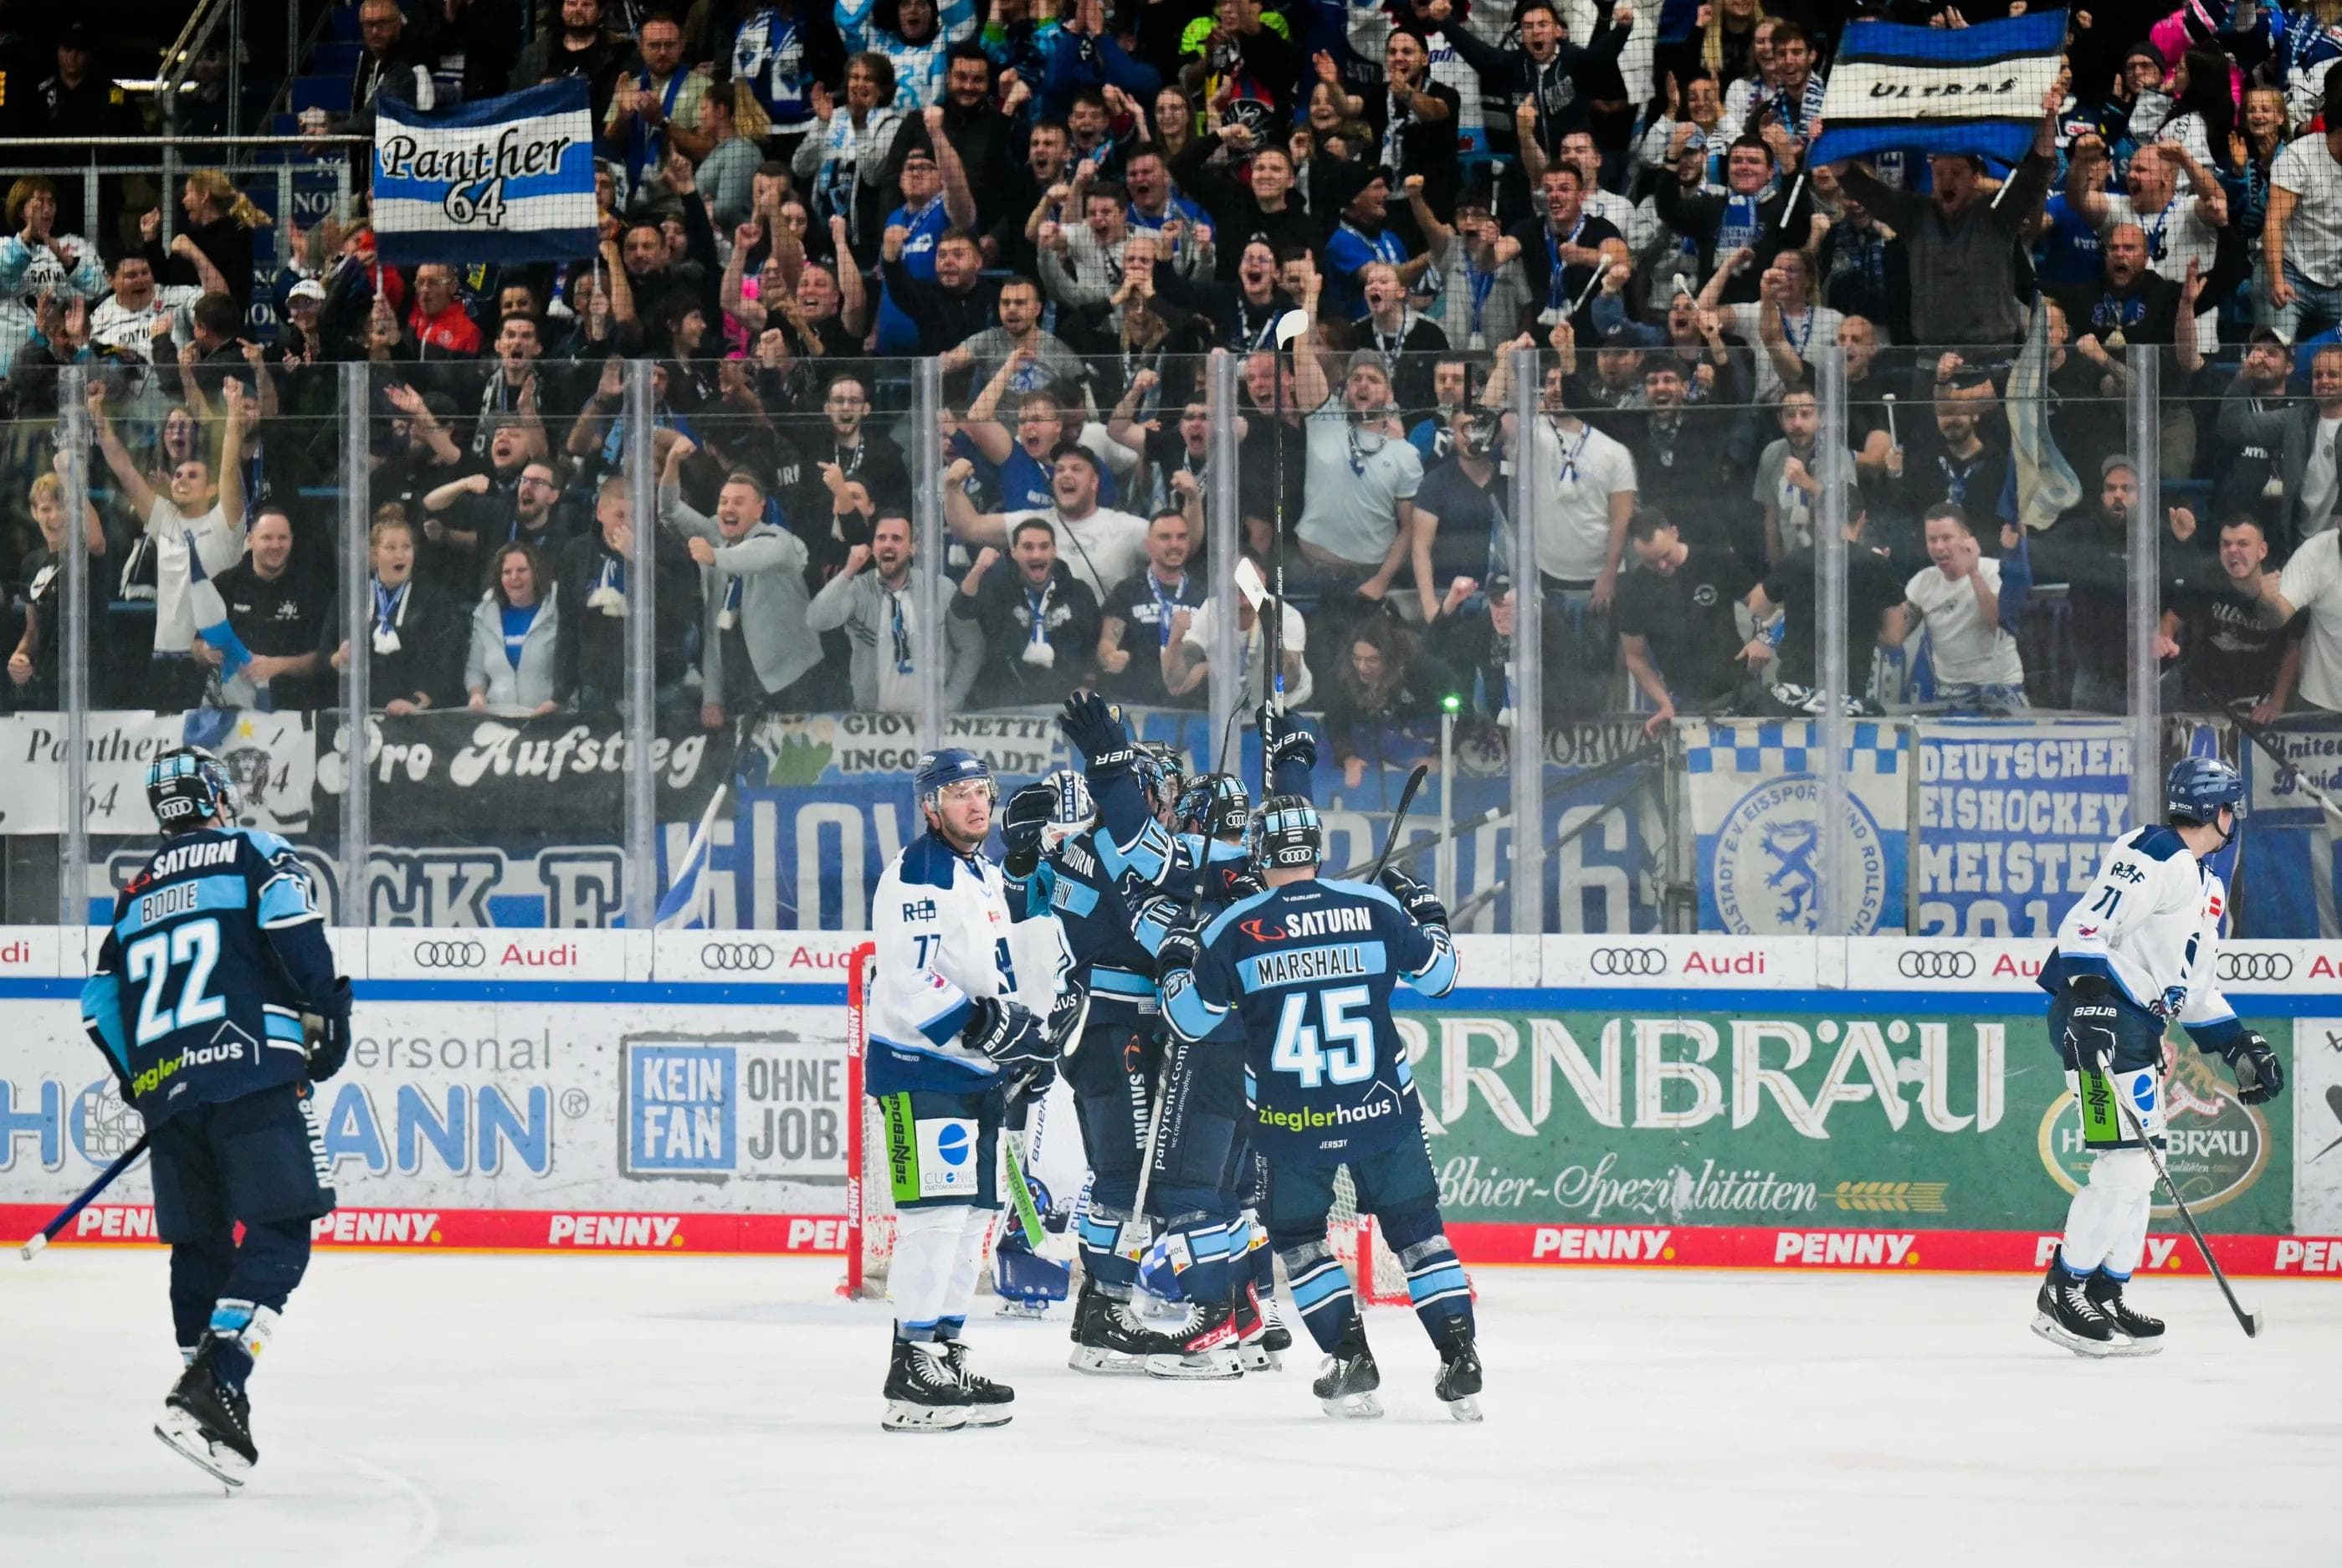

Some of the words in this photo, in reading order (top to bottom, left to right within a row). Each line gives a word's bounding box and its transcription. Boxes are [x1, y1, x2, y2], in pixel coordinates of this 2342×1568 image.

[1870, 77, 2017, 98] ULTRAS
[382, 126, 570, 180] Panther
[443, 178, 507, 226] 64
[841, 711, 1050, 740] GIOVNETTI
[317, 714, 433, 795] Pro
[450, 720, 708, 790] Aufsteg
[1919, 740, 2133, 783] DEUTSCHER
[1743, 784, 1819, 822] EISSPOR
[1919, 786, 2129, 837] EISHOCKEY
[151, 838, 237, 880] SATURN
[141, 881, 198, 925] BODIE
[1285, 907, 1372, 938] SATURN
[1919, 899, 2052, 938] 201
[2091, 884, 2123, 920] 71
[500, 943, 577, 966] Audi
[913, 934, 941, 969] 77
[1257, 946, 1366, 986] MARSHALL
[1683, 950, 1765, 975] Audi
[127, 918, 227, 1047] 22
[355, 1028, 551, 1069] ersonal
[1271, 985, 1376, 1089] 45
[643, 1057, 722, 1102] KEIN
[747, 1058, 841, 1103] OHNE
[643, 1105, 722, 1160] FAN
[748, 1107, 848, 1161] JOB.
[1258, 1099, 1392, 1132] zieglerhaus
[2062, 1128, 2249, 1158] HBRÄU
[310, 1213, 442, 1243] PENNY.
[549, 1216, 684, 1248] PENNY.
[1532, 1228, 1675, 1260] PENNY.
[1774, 1232, 1920, 1265] PENNY.
